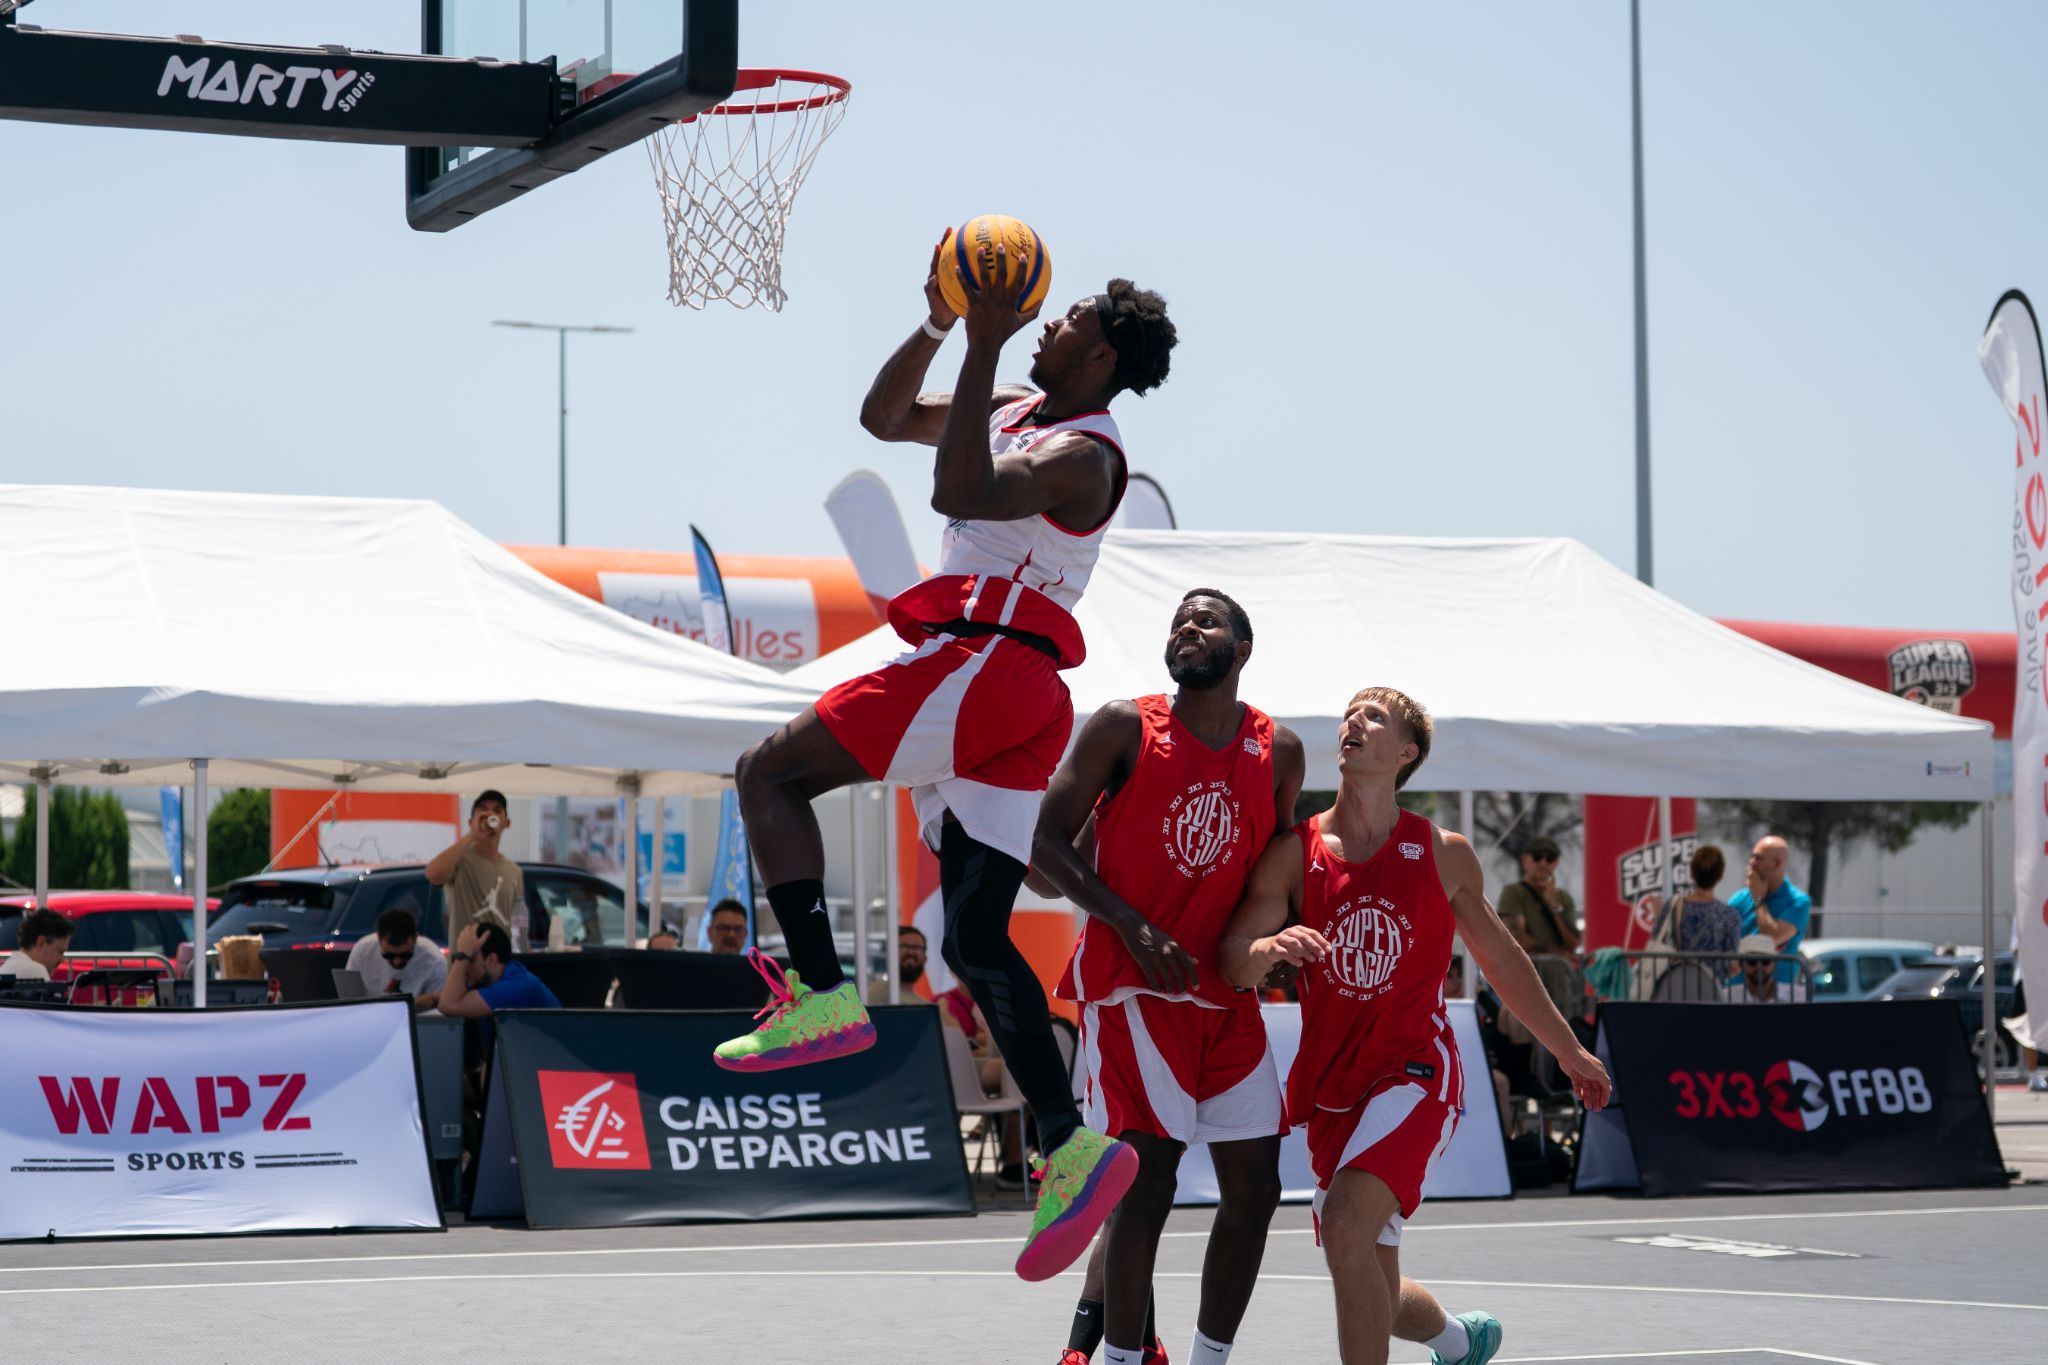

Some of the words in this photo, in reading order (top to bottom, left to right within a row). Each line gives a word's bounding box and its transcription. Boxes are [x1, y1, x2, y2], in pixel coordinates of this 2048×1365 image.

[157, 54, 357, 111] MARTY
[1890, 641, 1968, 672] SUPER
[1893, 662, 1971, 691] LEAGUE
[1331, 907, 1402, 956] SUPER
[1331, 946, 1402, 989] LEAGUE
[38, 1073, 312, 1135] WAPZ
[659, 1093, 826, 1131] CAISSE
[1669, 1071, 1761, 1118] 3X3
[1828, 1066, 1933, 1116] FFBB
[127, 1151, 245, 1171] SPORTS
[667, 1126, 931, 1171] D'EPARGNE
